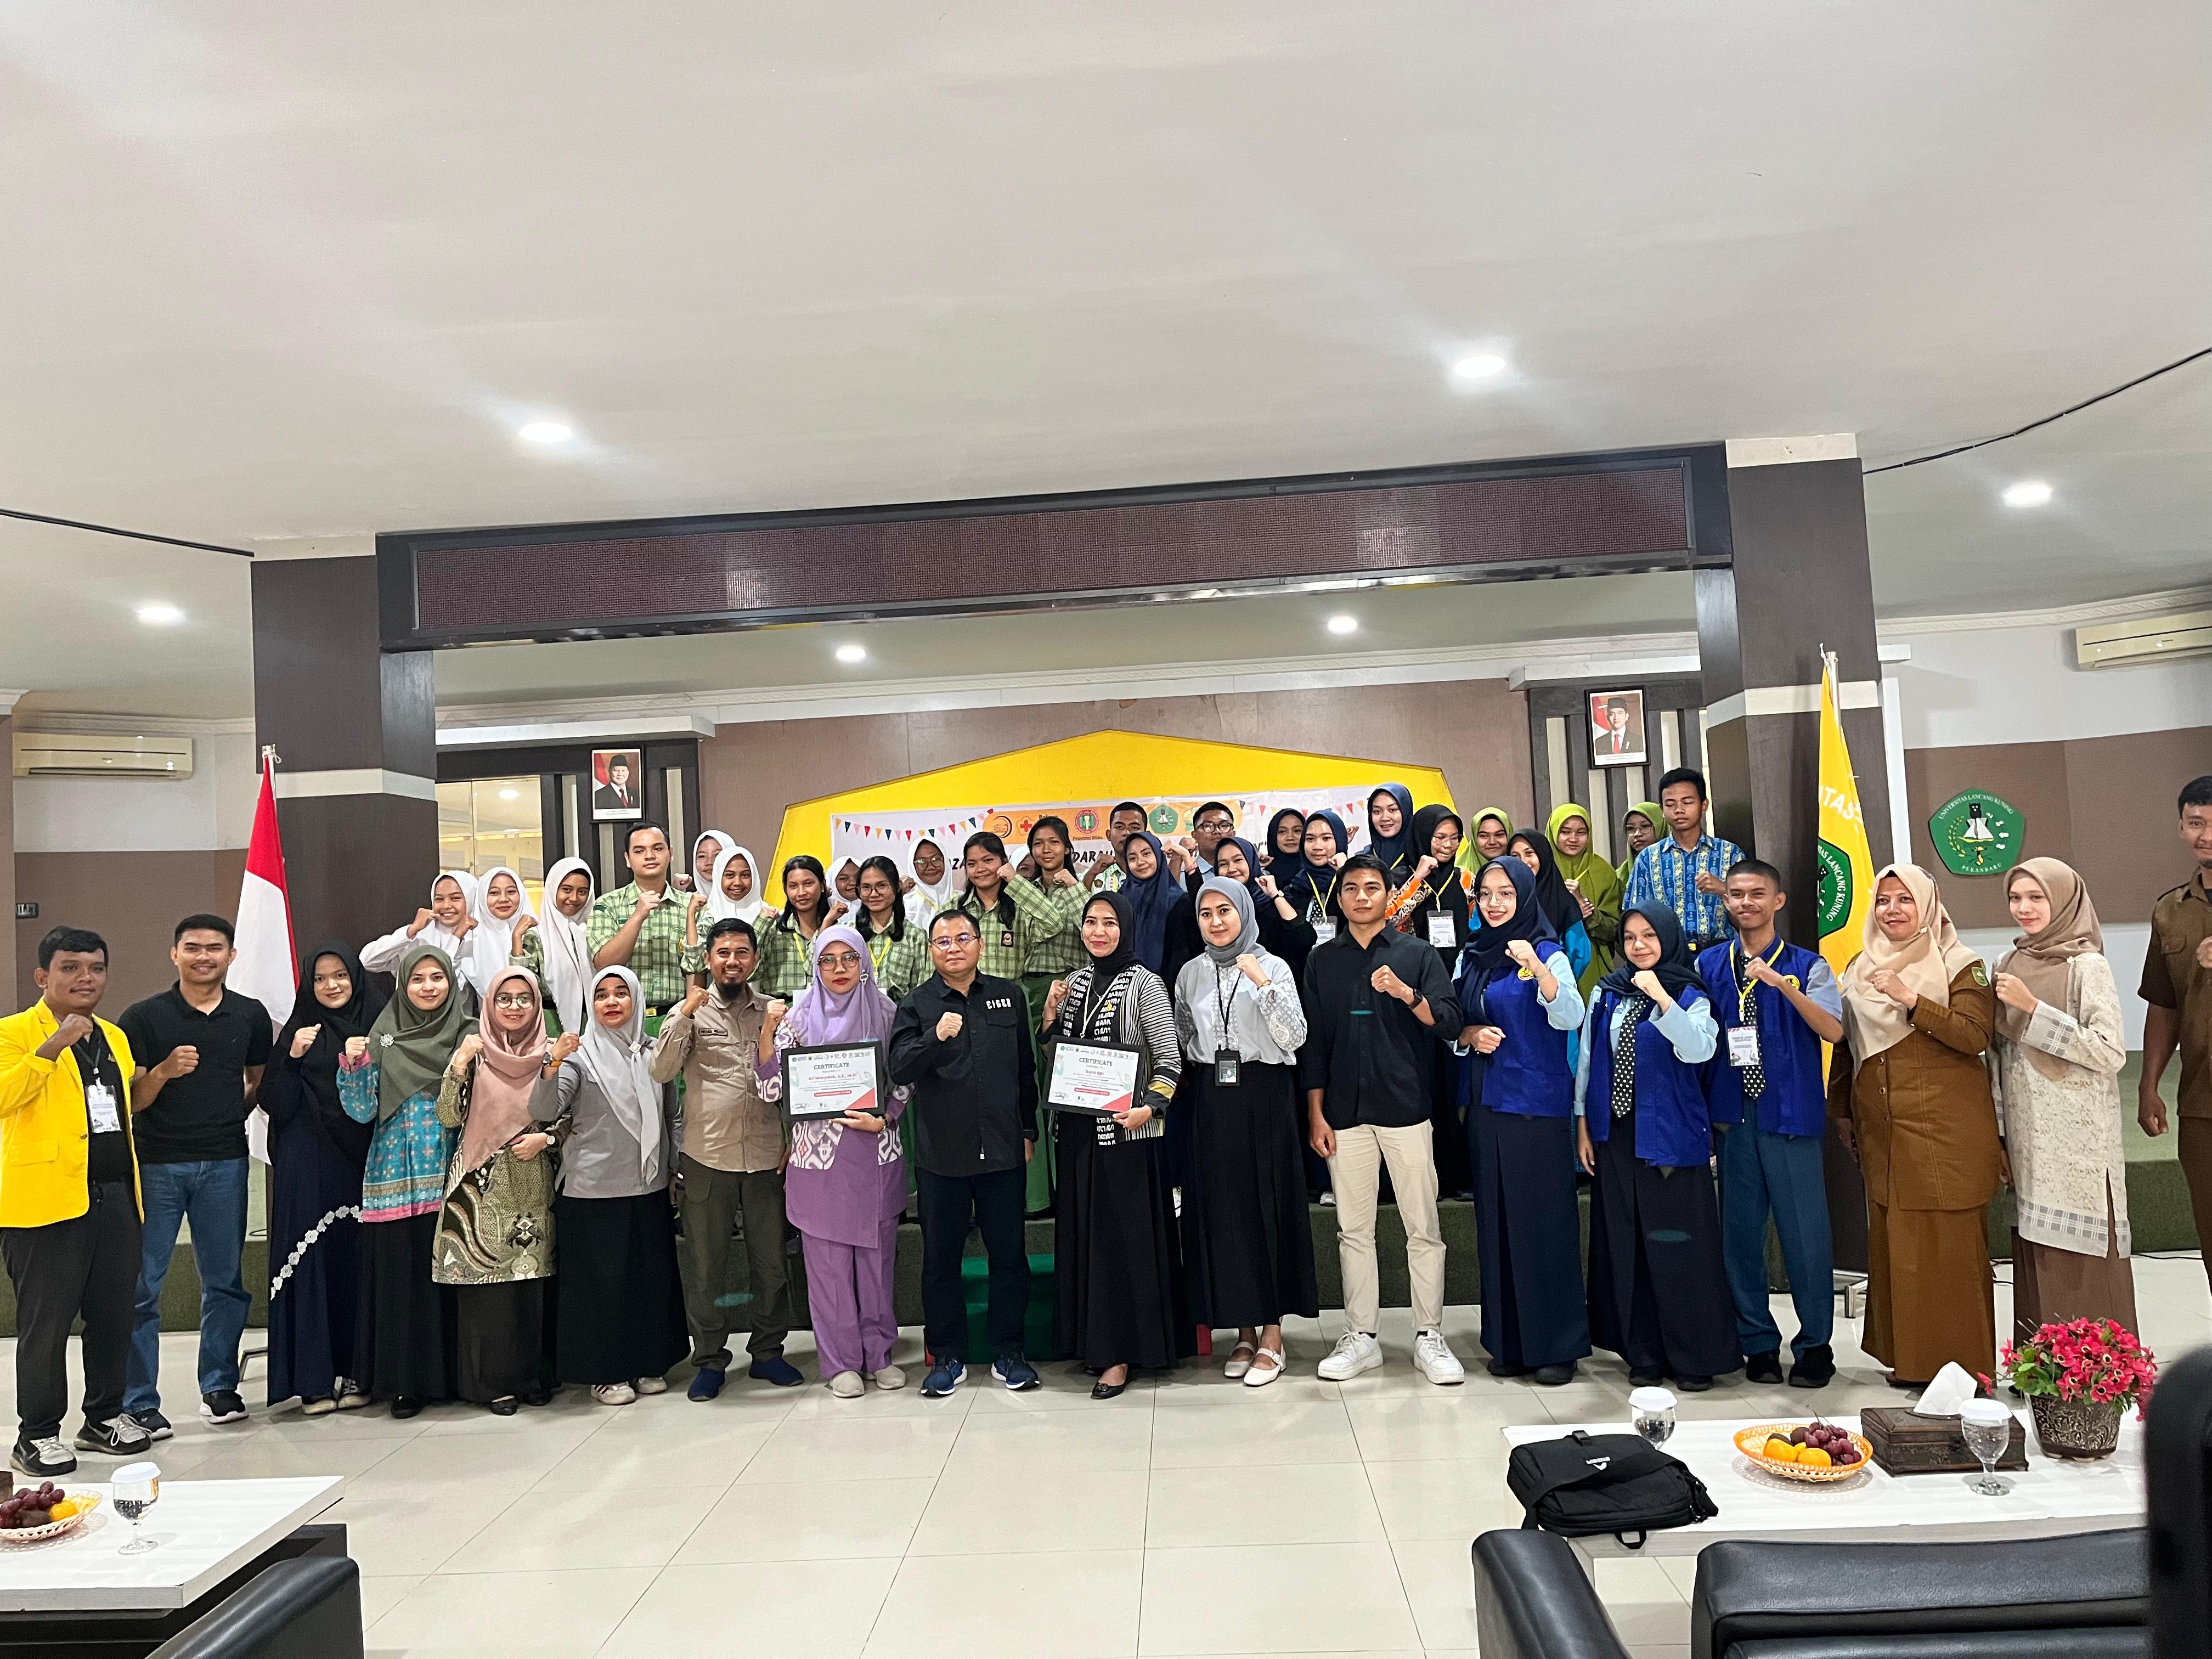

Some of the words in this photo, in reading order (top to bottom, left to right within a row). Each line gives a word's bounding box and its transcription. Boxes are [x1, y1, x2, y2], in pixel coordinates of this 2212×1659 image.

[1938, 795, 1967, 820] UNIVERSITAS
[1968, 794, 1994, 802] LANCANG
[1994, 797, 2013, 814] KUNING
[1826, 855, 1846, 891] LANCANG
[1961, 862, 2002, 873] PEKANBARU
[1826, 893, 1846, 922] KUNING
[1079, 1057, 1113, 1066] CERTIFICATE
